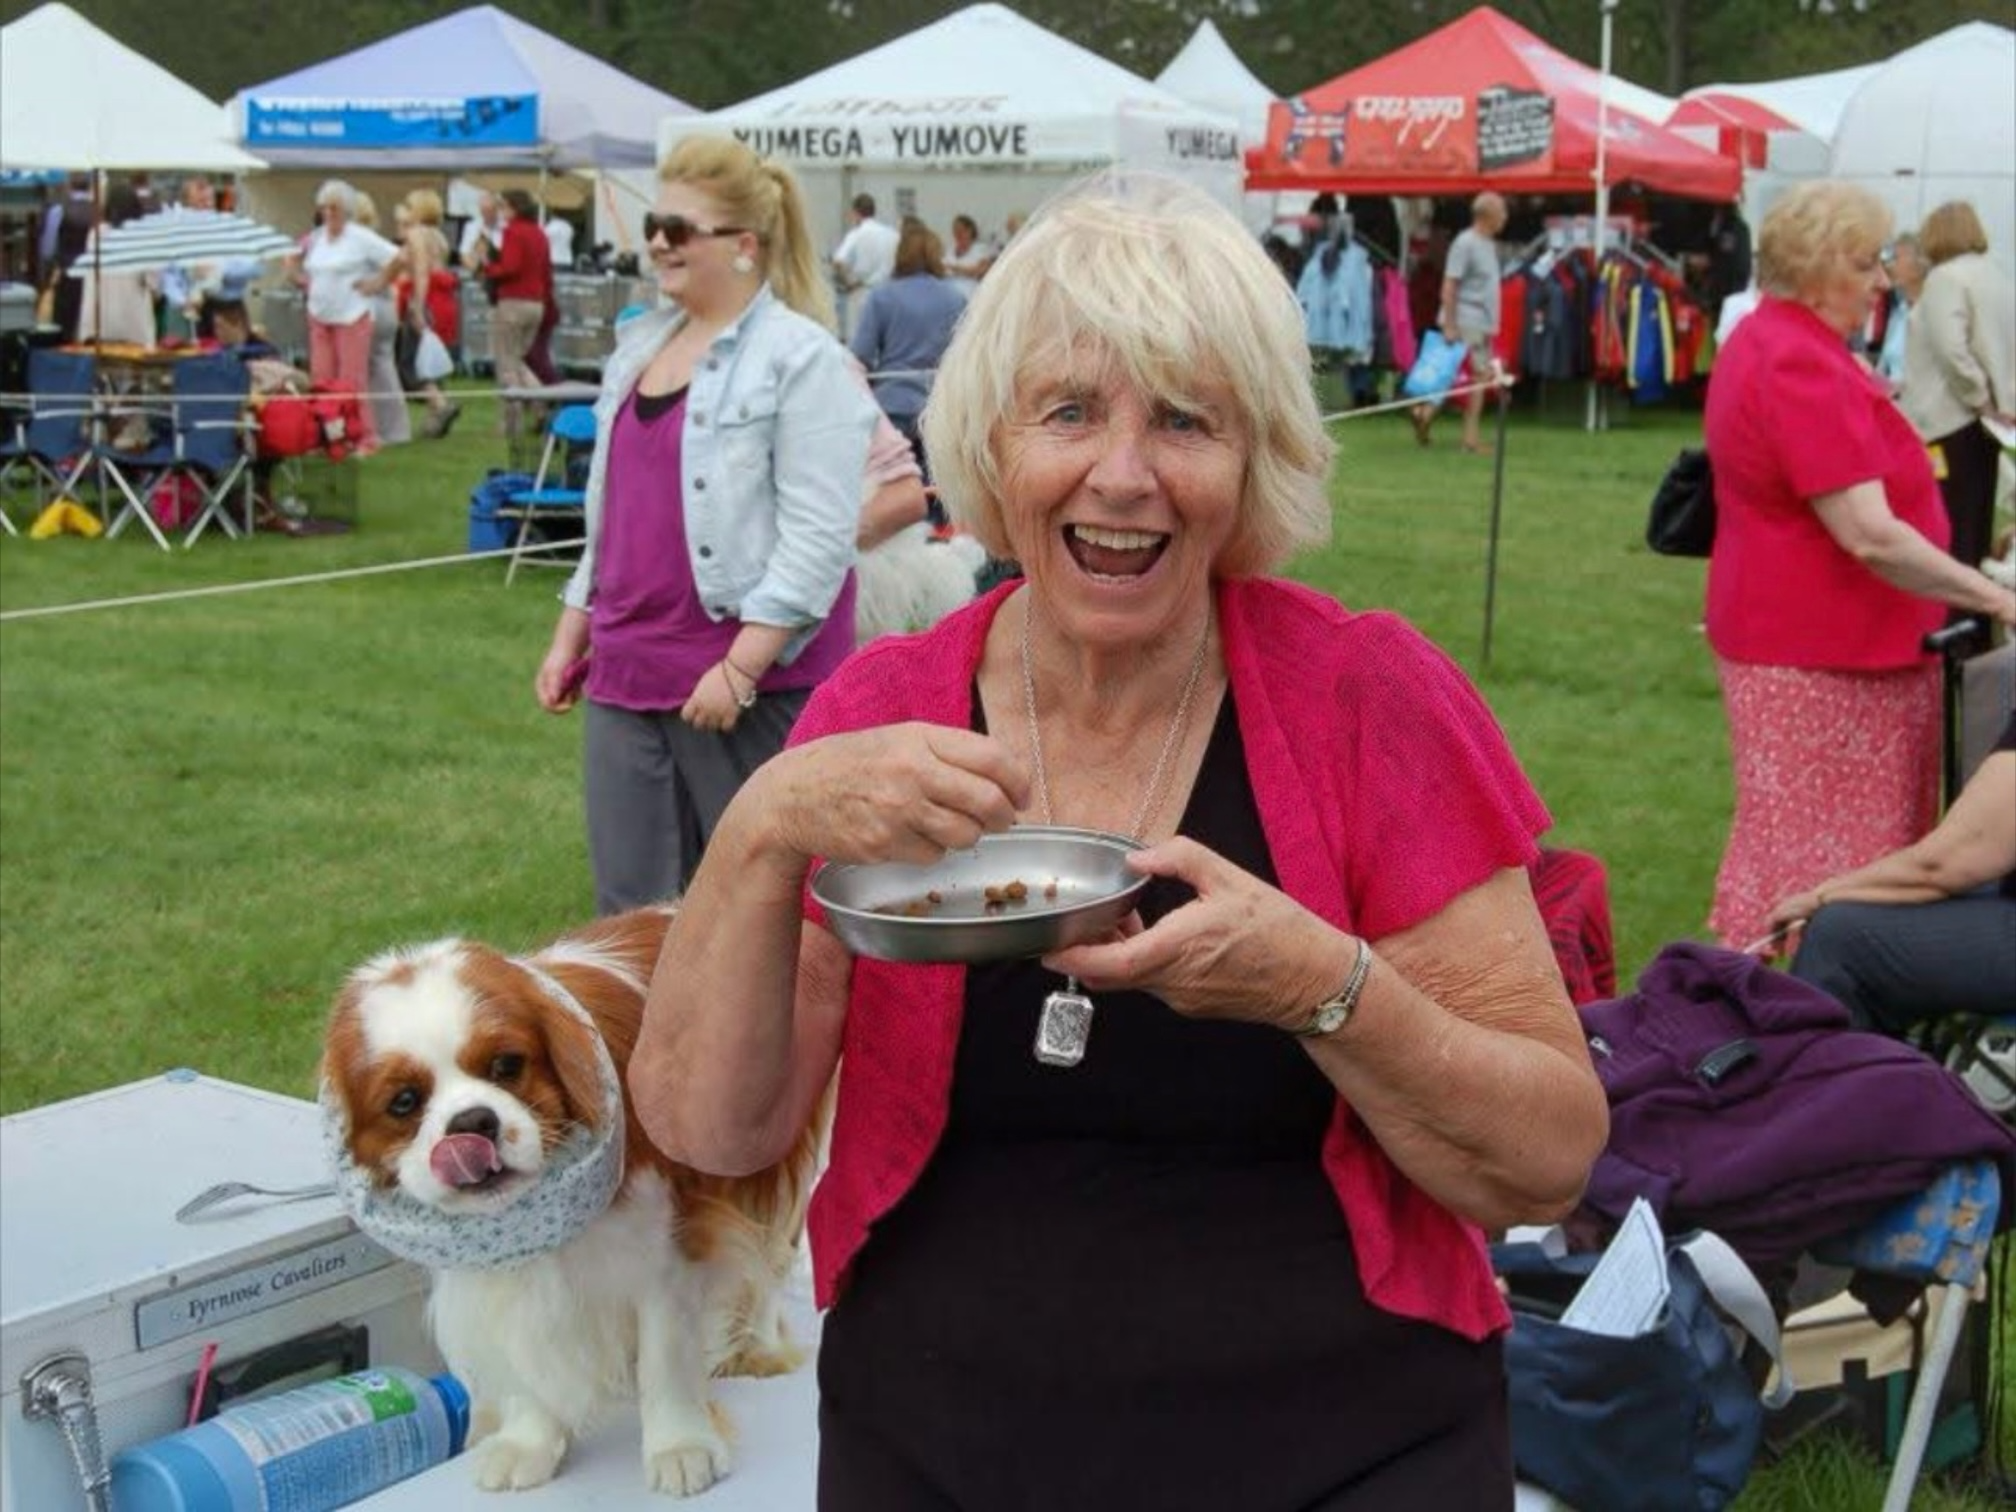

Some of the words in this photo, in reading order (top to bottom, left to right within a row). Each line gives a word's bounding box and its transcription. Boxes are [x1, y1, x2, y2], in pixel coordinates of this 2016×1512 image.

[733, 126, 863, 158] YUMEGA
[891, 124, 1028, 157] YUMOVE
[270, 1254, 347, 1291] Cavaliers
